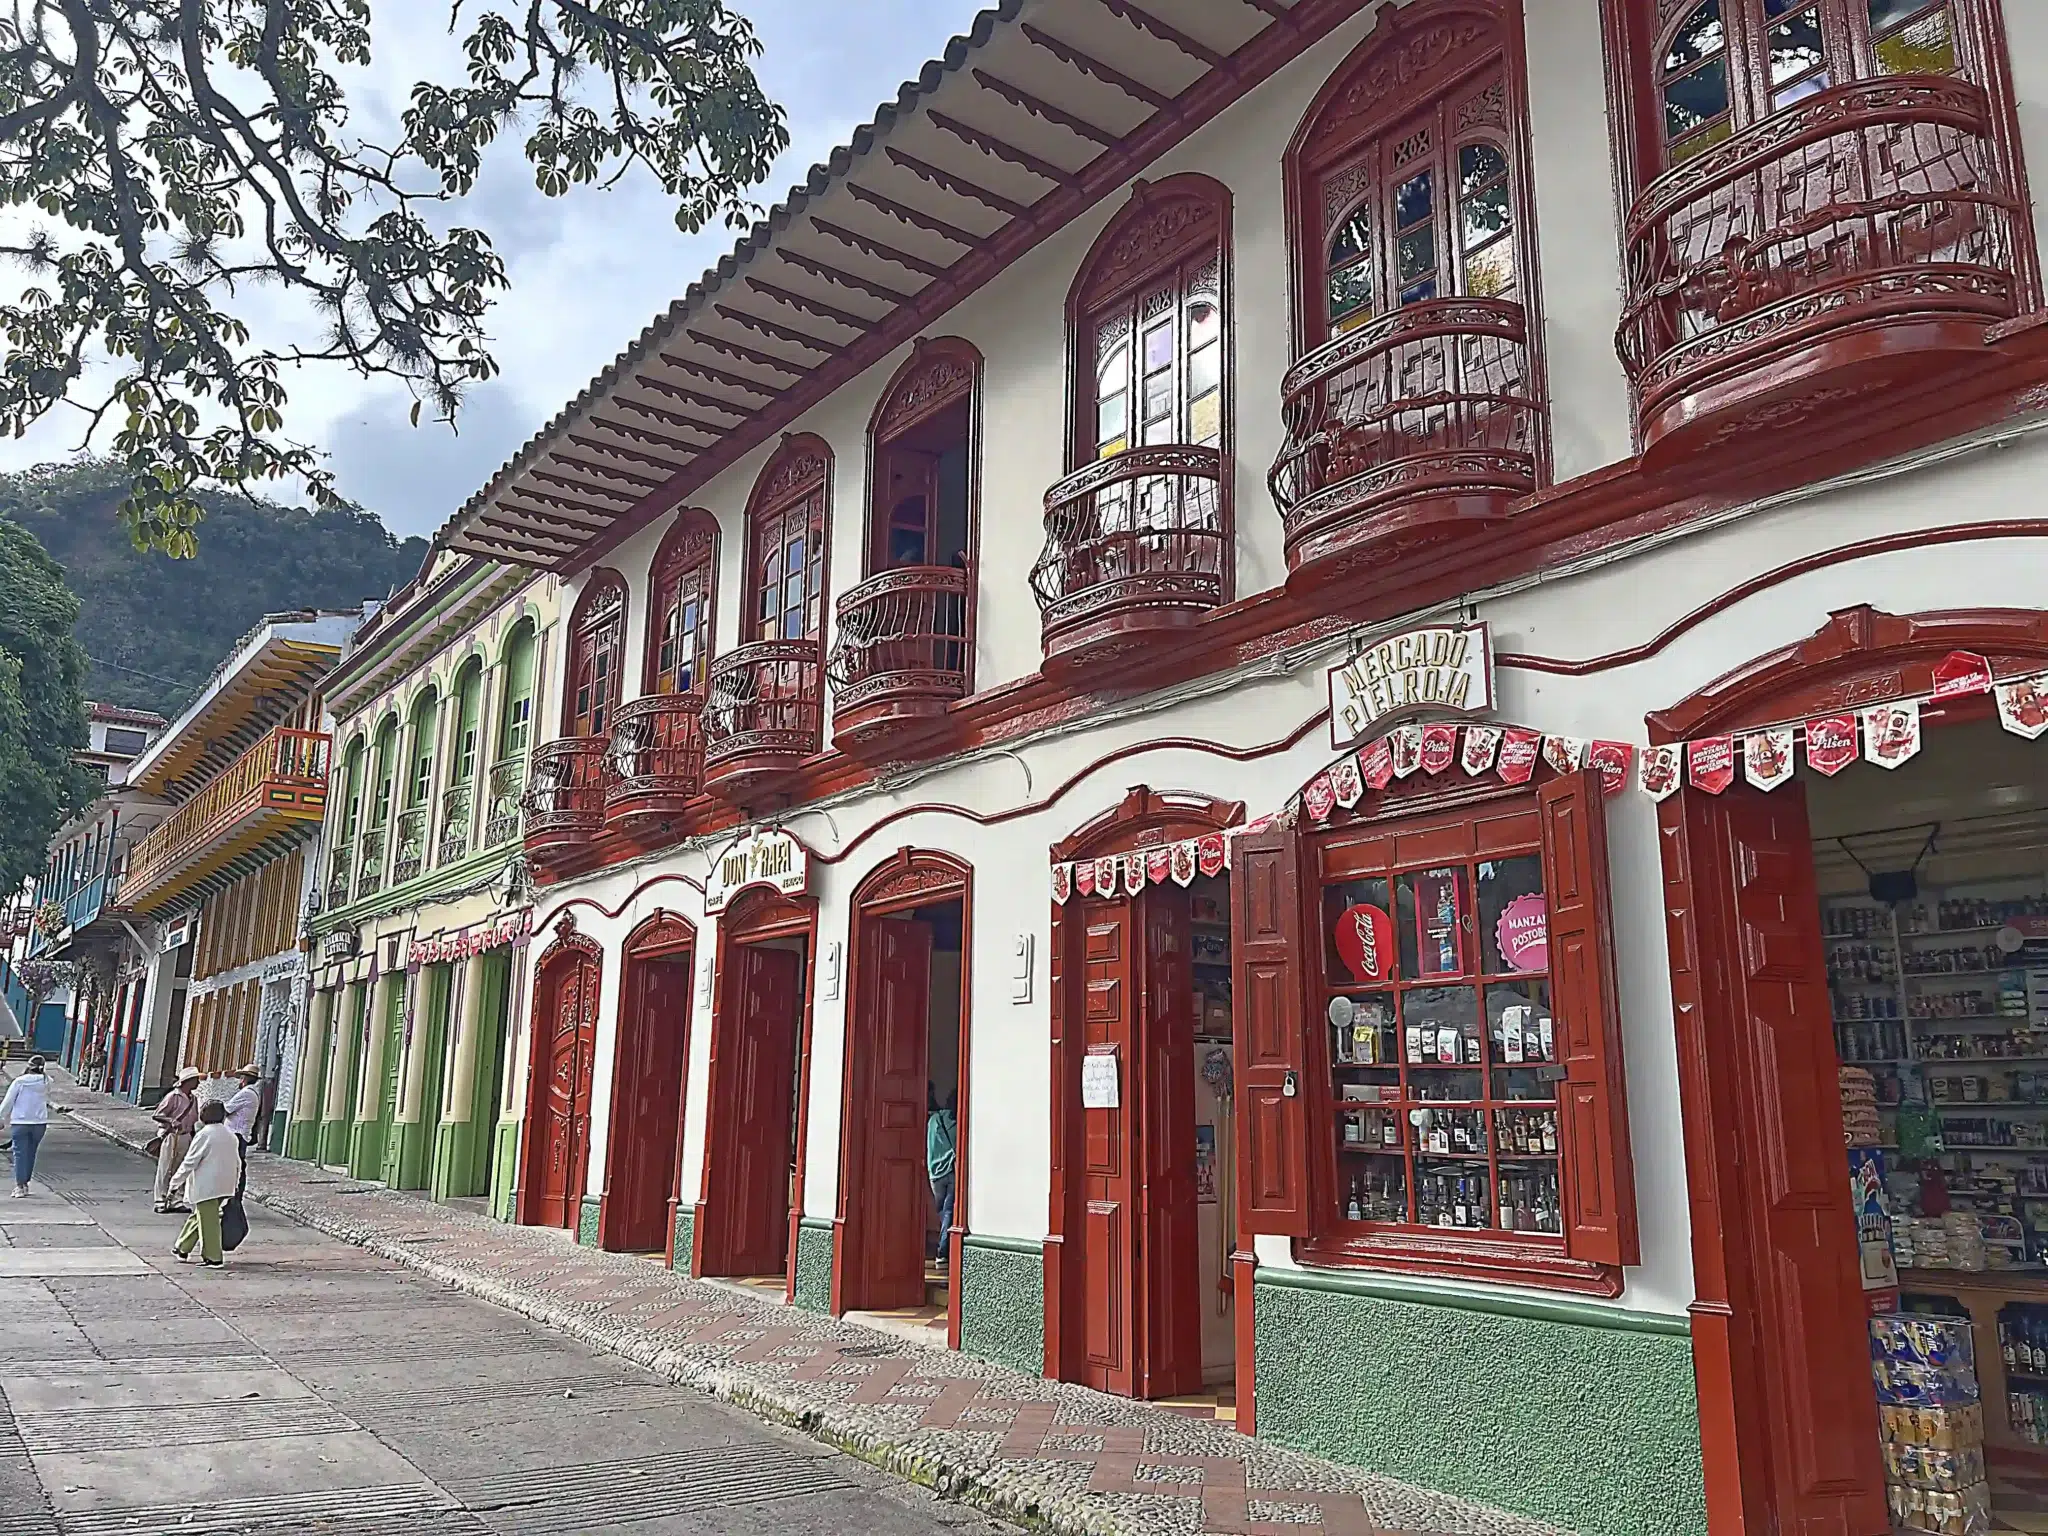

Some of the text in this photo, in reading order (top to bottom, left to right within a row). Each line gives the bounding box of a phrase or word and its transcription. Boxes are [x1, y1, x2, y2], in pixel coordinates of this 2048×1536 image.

[1341, 632, 1468, 699] MERCADO
[1339, 668, 1471, 737] PIELROJA
[1424, 740, 1450, 753] Pilsen
[1810, 735, 1851, 751] Pilsen
[723, 840, 791, 887] DON RAFA
[707, 891, 724, 907] CAFÉ
